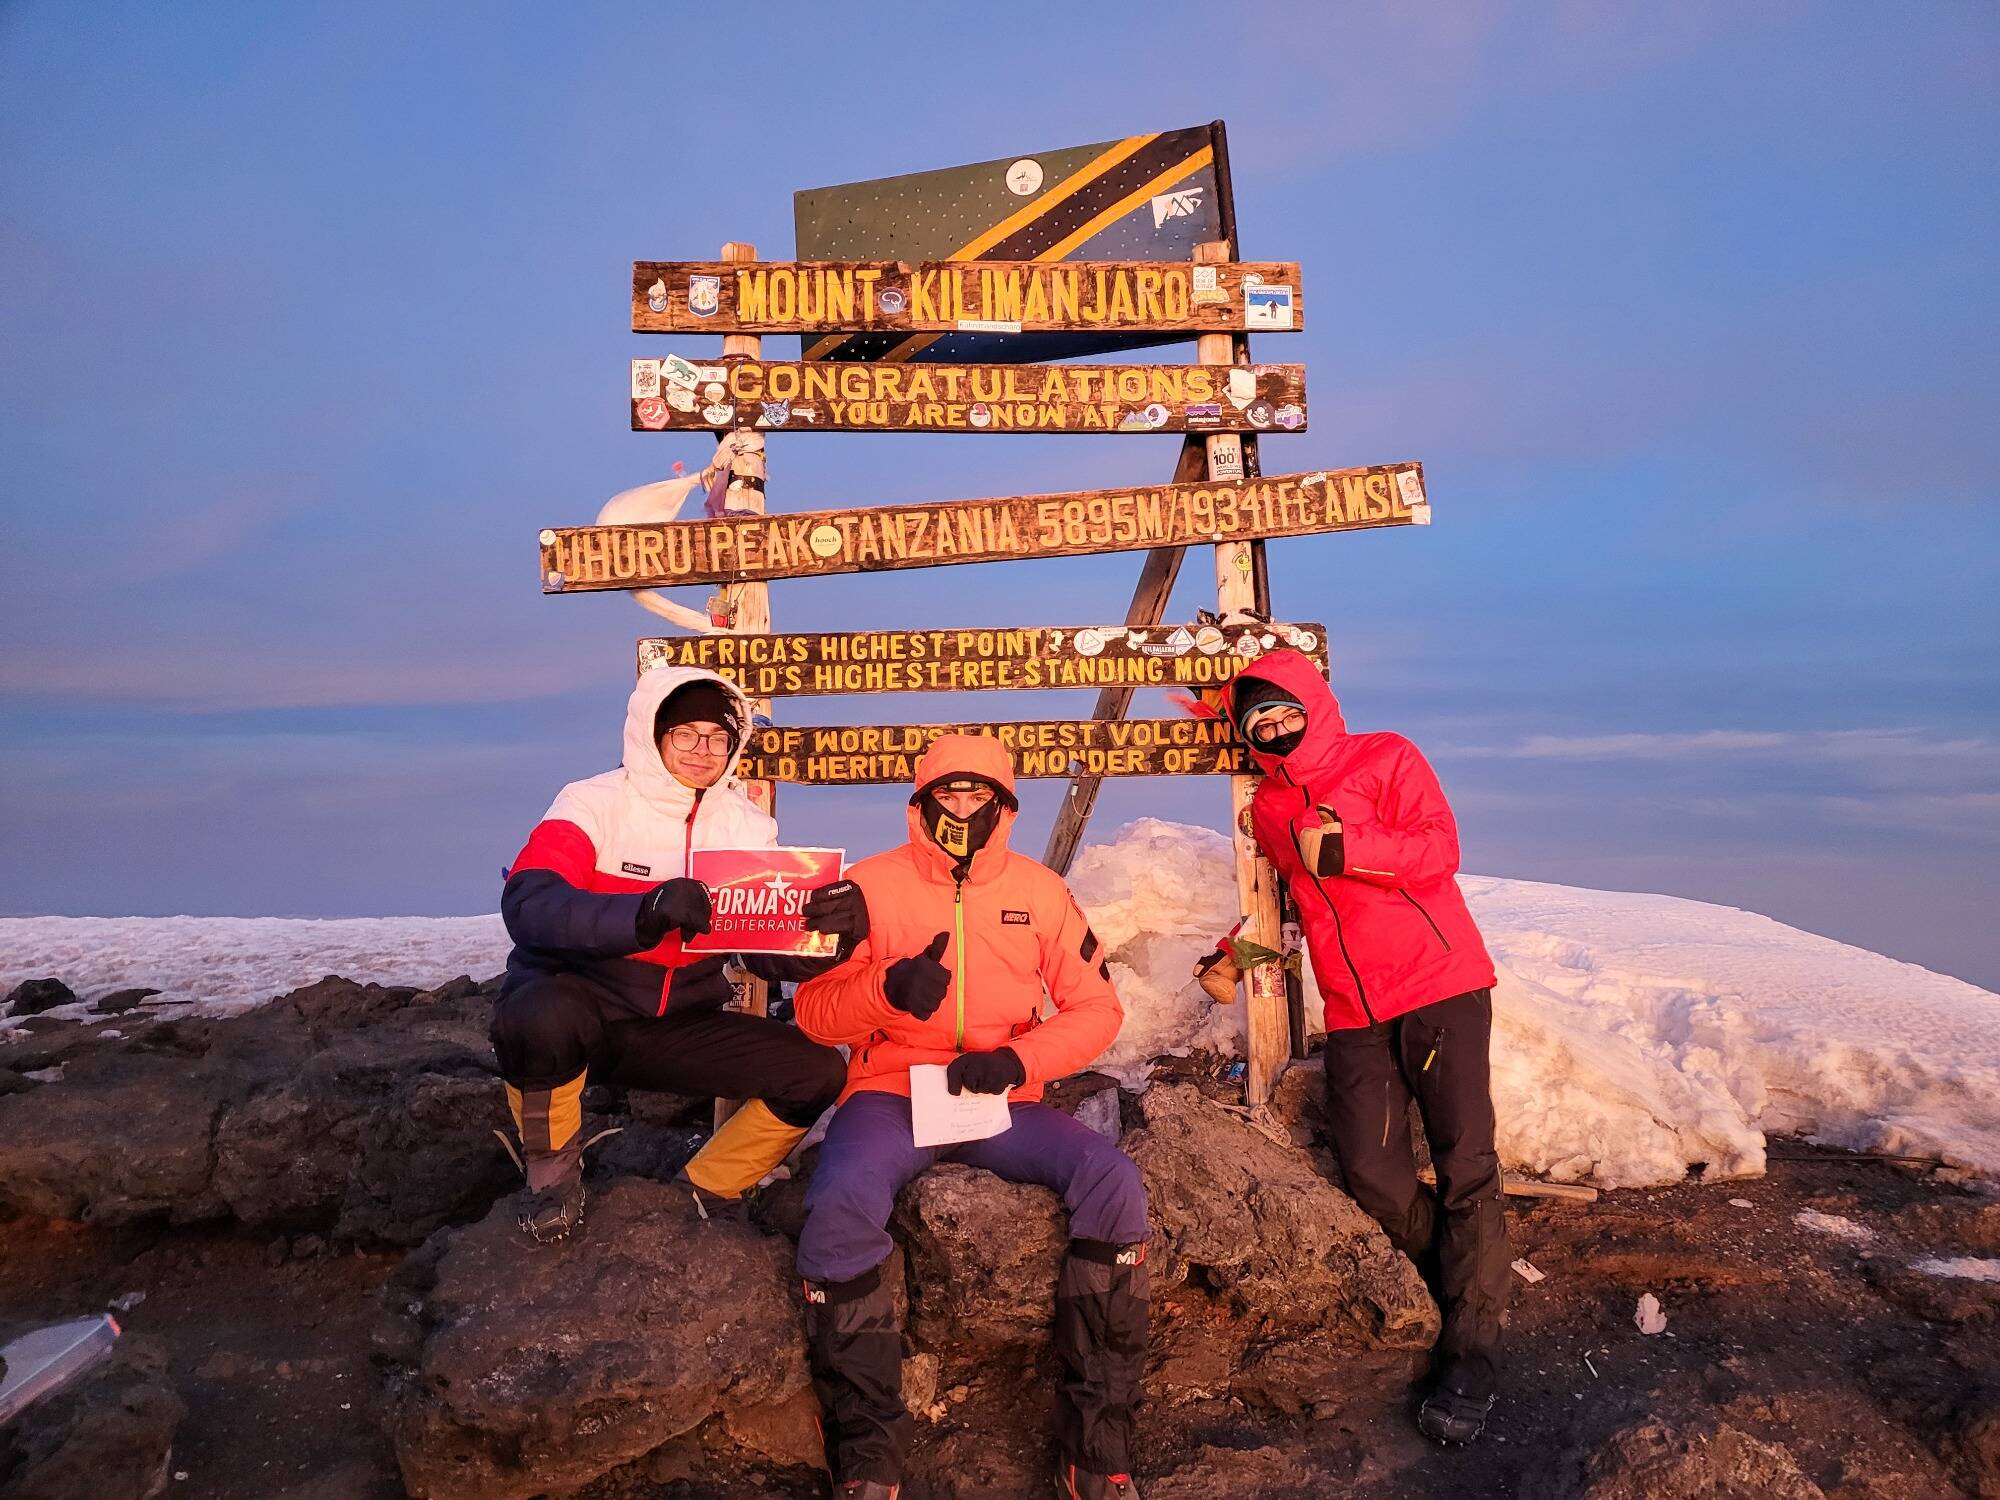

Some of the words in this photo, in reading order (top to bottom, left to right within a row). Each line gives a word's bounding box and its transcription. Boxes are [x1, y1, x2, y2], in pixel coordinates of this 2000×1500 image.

[739, 269, 882, 322] MOUNT
[911, 269, 1188, 321] KILIMANJARO
[730, 364, 1214, 401] CONGRATULATIONS
[829, 401, 889, 425] YOU
[905, 403, 967, 427] ARE
[991, 403, 1067, 428] NOW
[1084, 404, 1119, 428] AT
[1188, 416, 1221, 424] patagonia
[555, 525, 693, 581] UHURU
[1325, 472, 1412, 523] AMSL
[814, 536, 838, 544] hooch
[679, 636, 809, 665] AFRICA'S
[820, 633, 945, 661] HIGHEST
[957, 631, 1041, 657] POINT
[719, 665, 802, 693] RLD'S
[815, 662, 942, 690] HIGHEST
[1175, 656, 1263, 682] MOUN
[762, 730, 800, 753] OF
[808, 755, 926, 780] HERITA
[1164, 748, 1200, 771] OF
[623, 863, 649, 875] ellesse
[784, 889, 812, 916] SU
[827, 883, 853, 896] reusch
[710, 917, 806, 932] ÉDITERRANÉ
[1003, 911, 1028, 923] HERO
